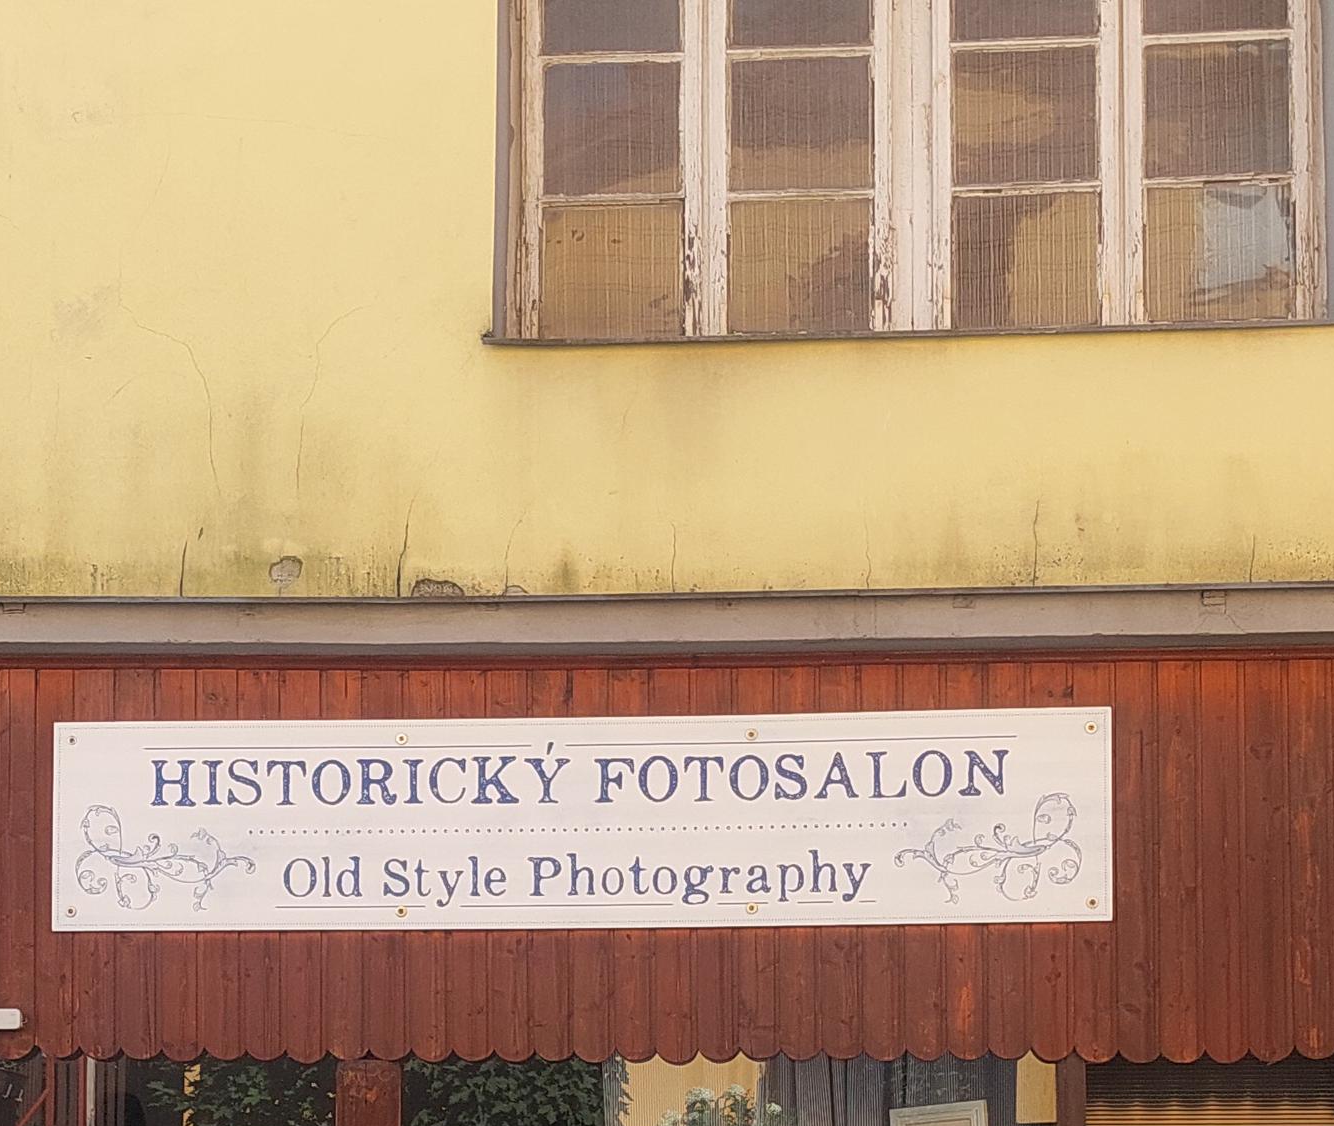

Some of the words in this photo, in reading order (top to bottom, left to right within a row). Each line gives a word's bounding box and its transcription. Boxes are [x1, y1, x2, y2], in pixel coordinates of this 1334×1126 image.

[150, 741, 570, 807] HISTORICKÝ
[593, 749, 1009, 803] FOTOSALON
[282, 856, 363, 898] Old
[382, 856, 508, 907] Style
[527, 849, 872, 906] Photography
